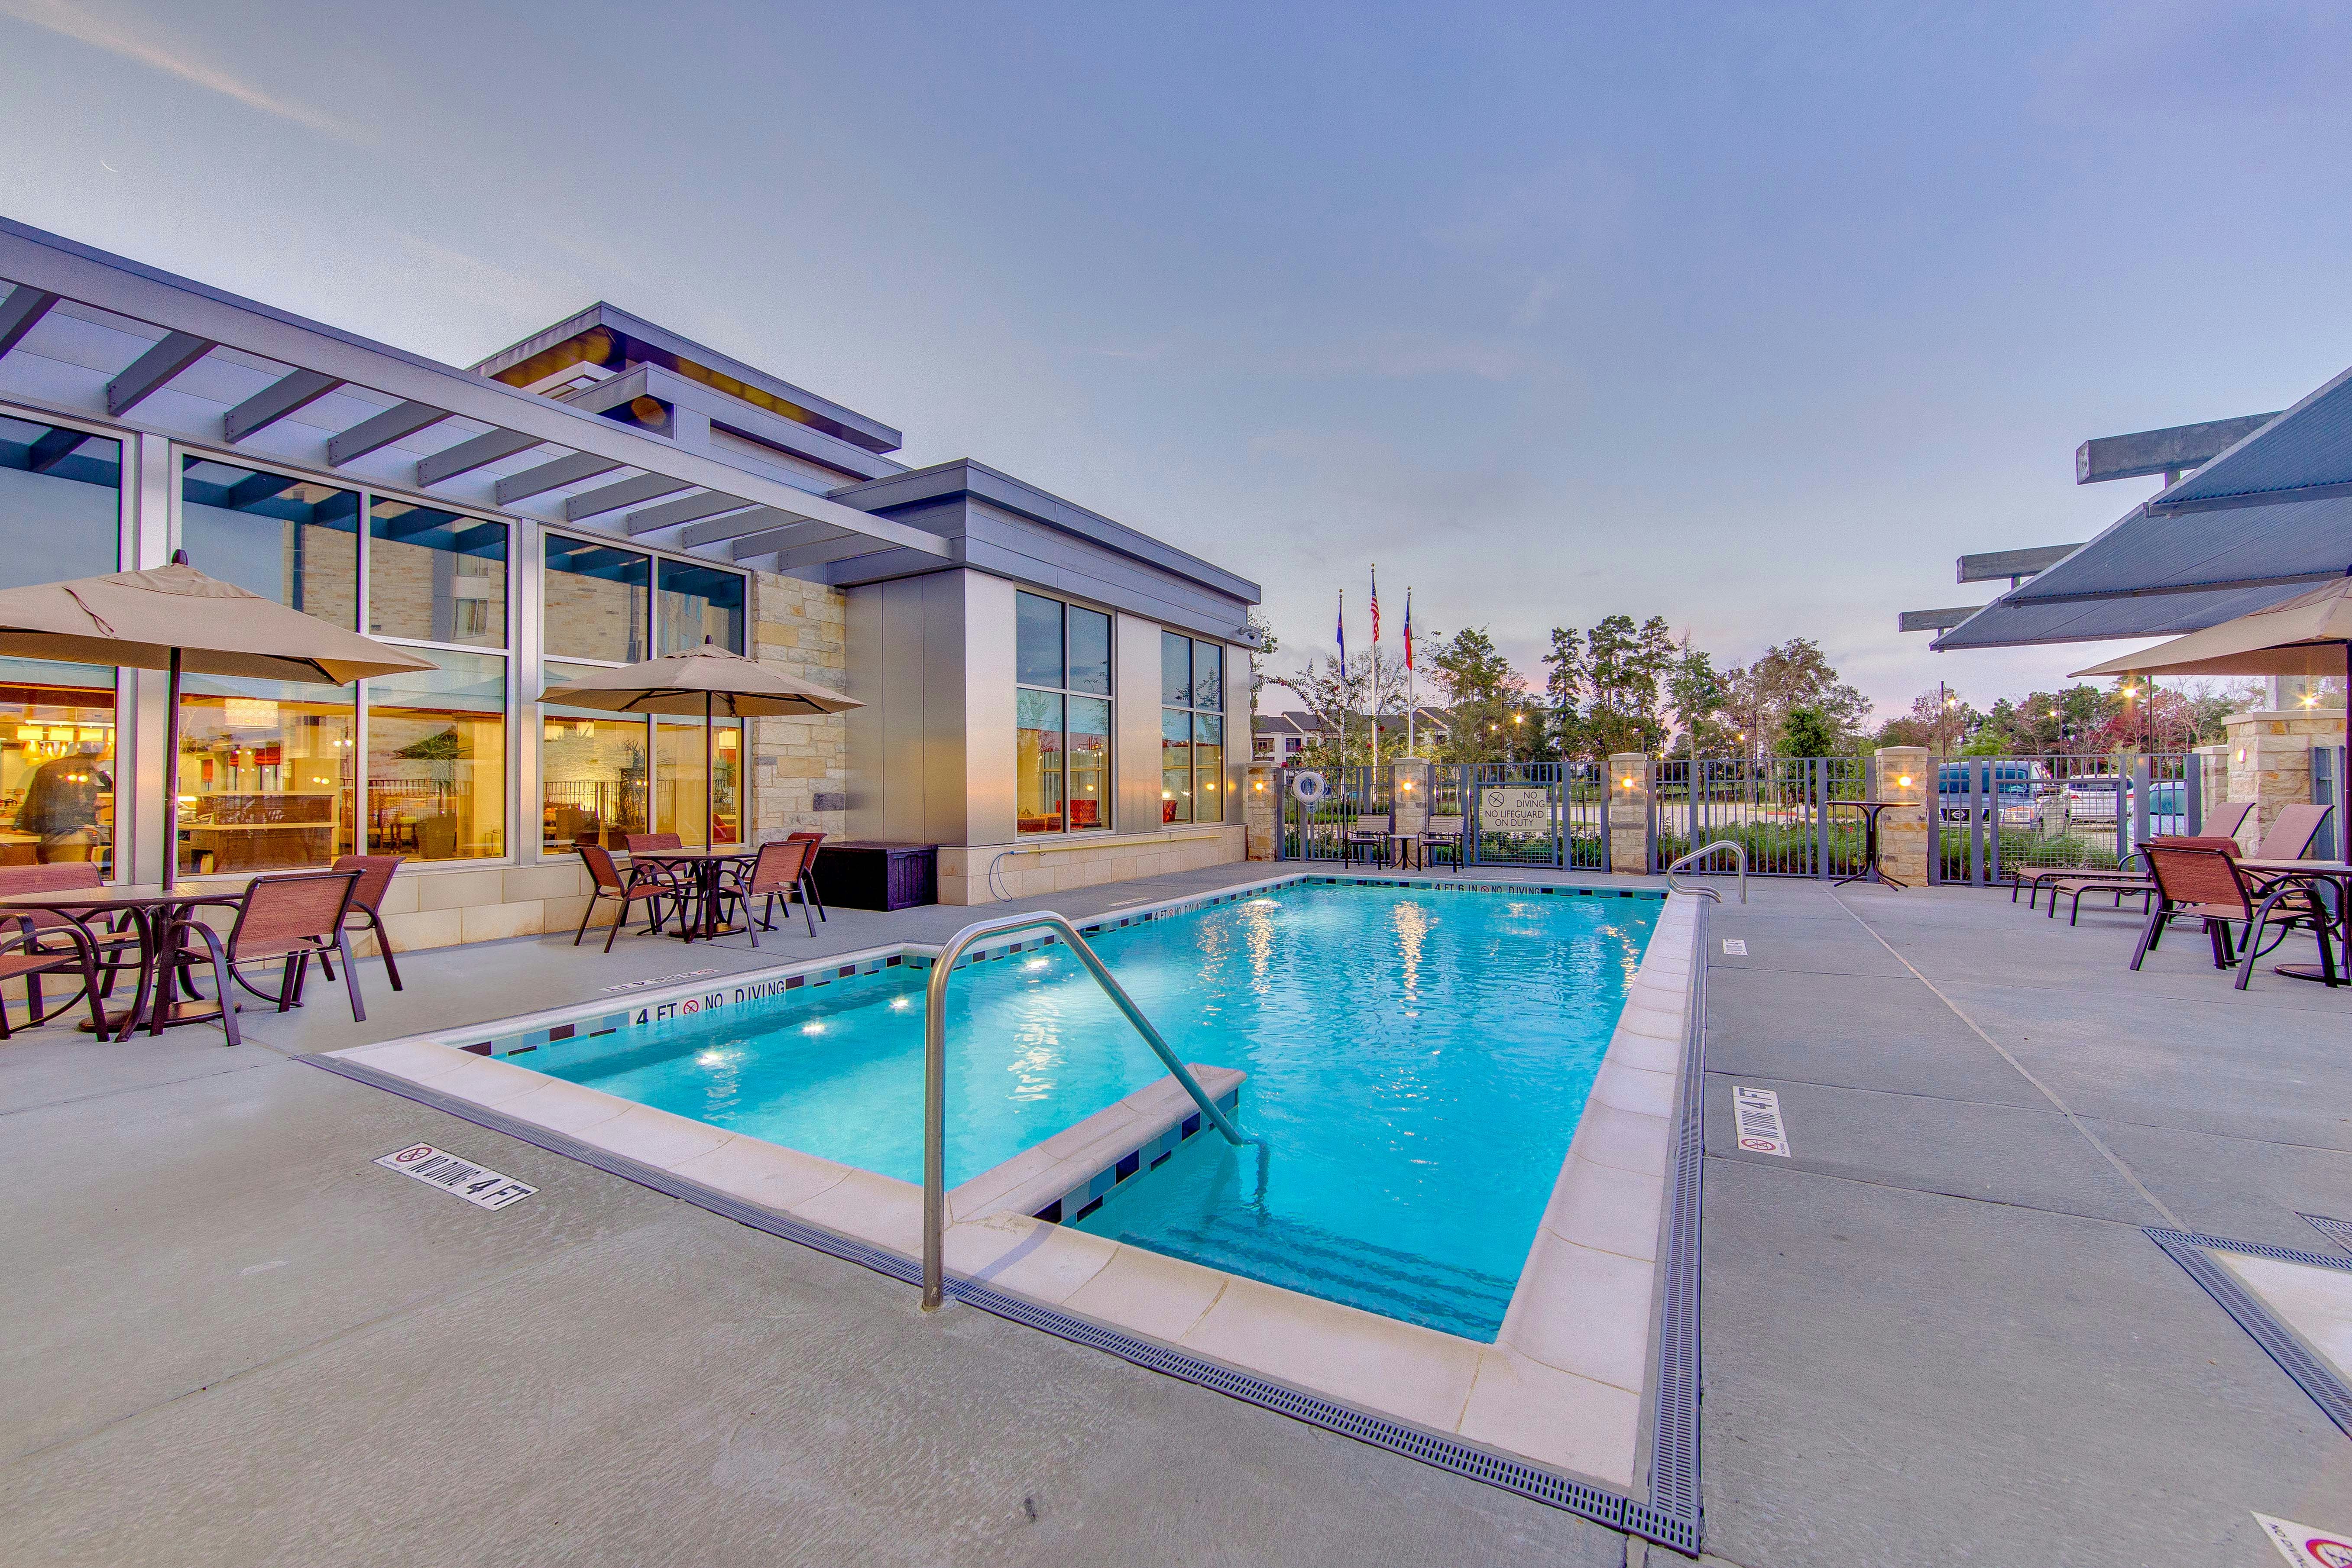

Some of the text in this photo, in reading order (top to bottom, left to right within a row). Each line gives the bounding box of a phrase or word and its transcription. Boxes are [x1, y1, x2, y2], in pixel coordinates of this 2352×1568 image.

[1154, 902, 1201, 920] 4 FT NO DIVING
[636, 980, 784, 1024] 4 FT NO DIVING
[1739, 1087, 1780, 1140] NO DIVING 4 FT
[407, 1155, 531, 1205] NO DIVING 4 FT
